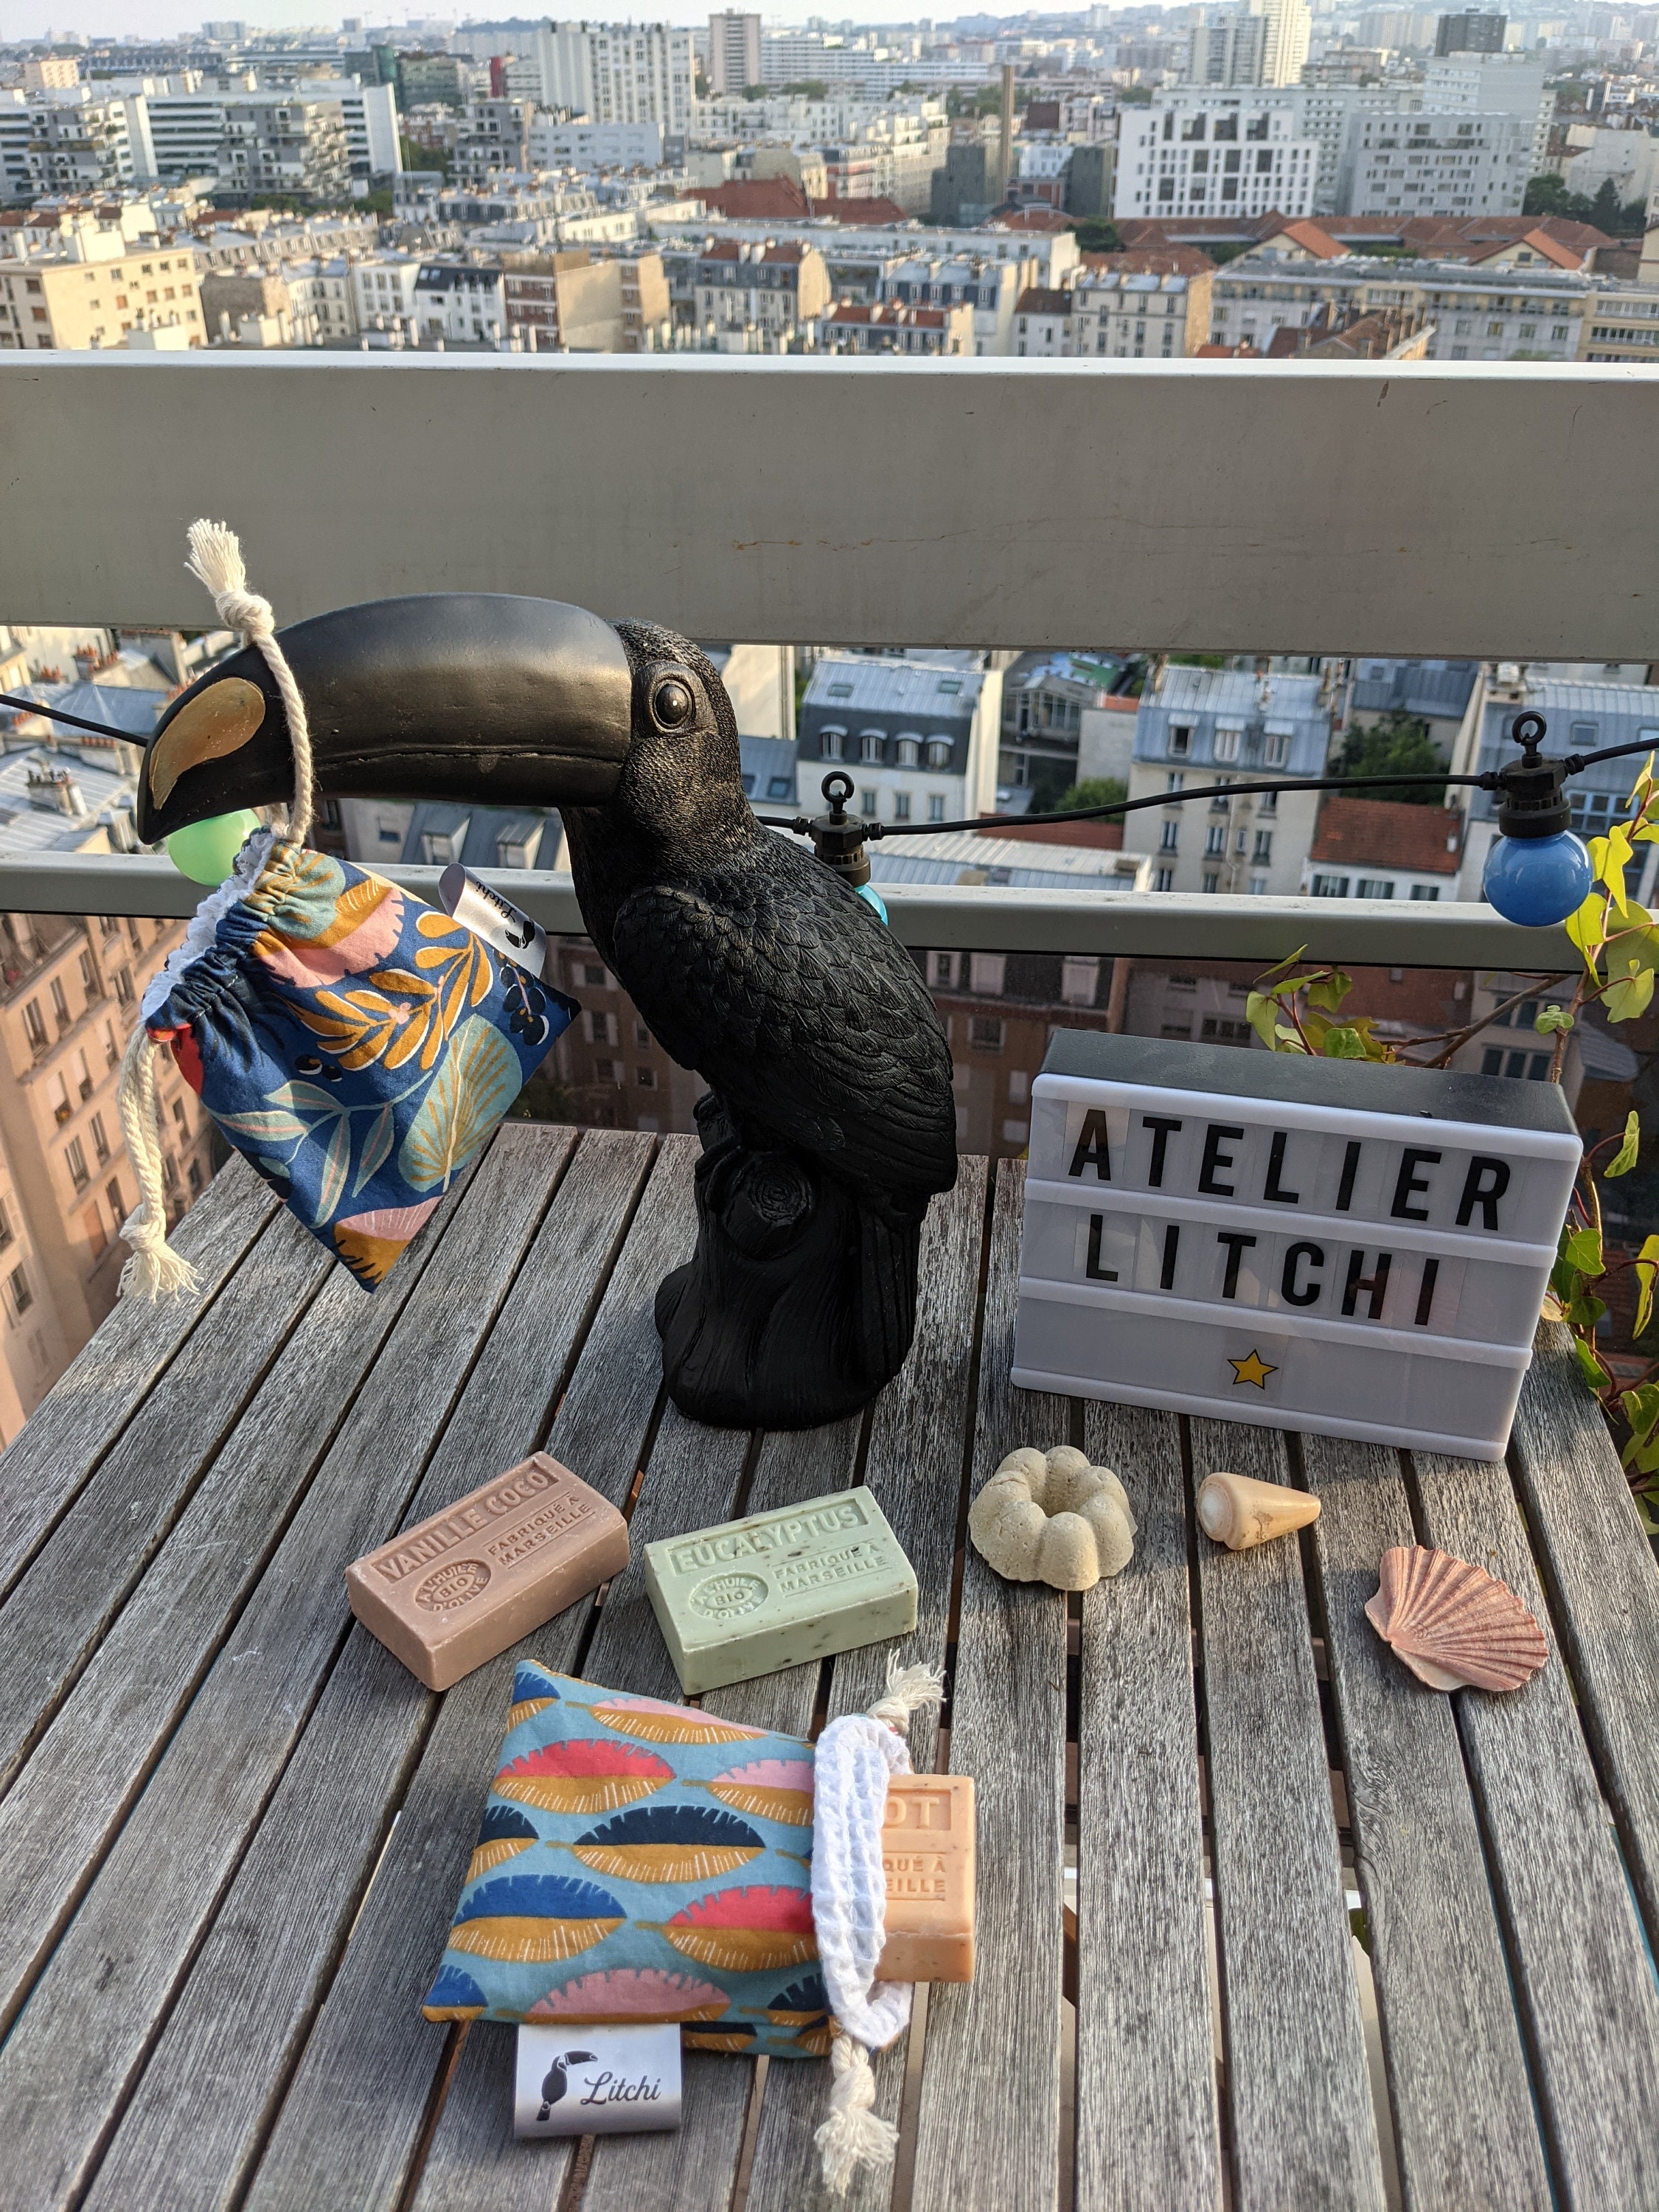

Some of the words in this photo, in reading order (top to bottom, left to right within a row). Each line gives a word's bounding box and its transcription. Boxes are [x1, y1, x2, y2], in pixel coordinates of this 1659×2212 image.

[476, 880, 518, 923] Litchi
[1068, 1109, 1511, 1231] ATELIER
[1085, 1214, 1439, 1326] LITCHI
[380, 1509, 487, 1581] VANILLE
[485, 1472, 549, 1516] COCO
[487, 1503, 566, 1556] FABRIQUÉ
[498, 1503, 592, 1565] MARSEILLE
[675, 1506, 859, 1573] EUCALYPTUS
[438, 1577, 469, 1599] BIO
[714, 1590, 745, 1606] BIO
[779, 1556, 888, 1593] MARSEILLE
[580, 2071, 661, 2105] Litchi
